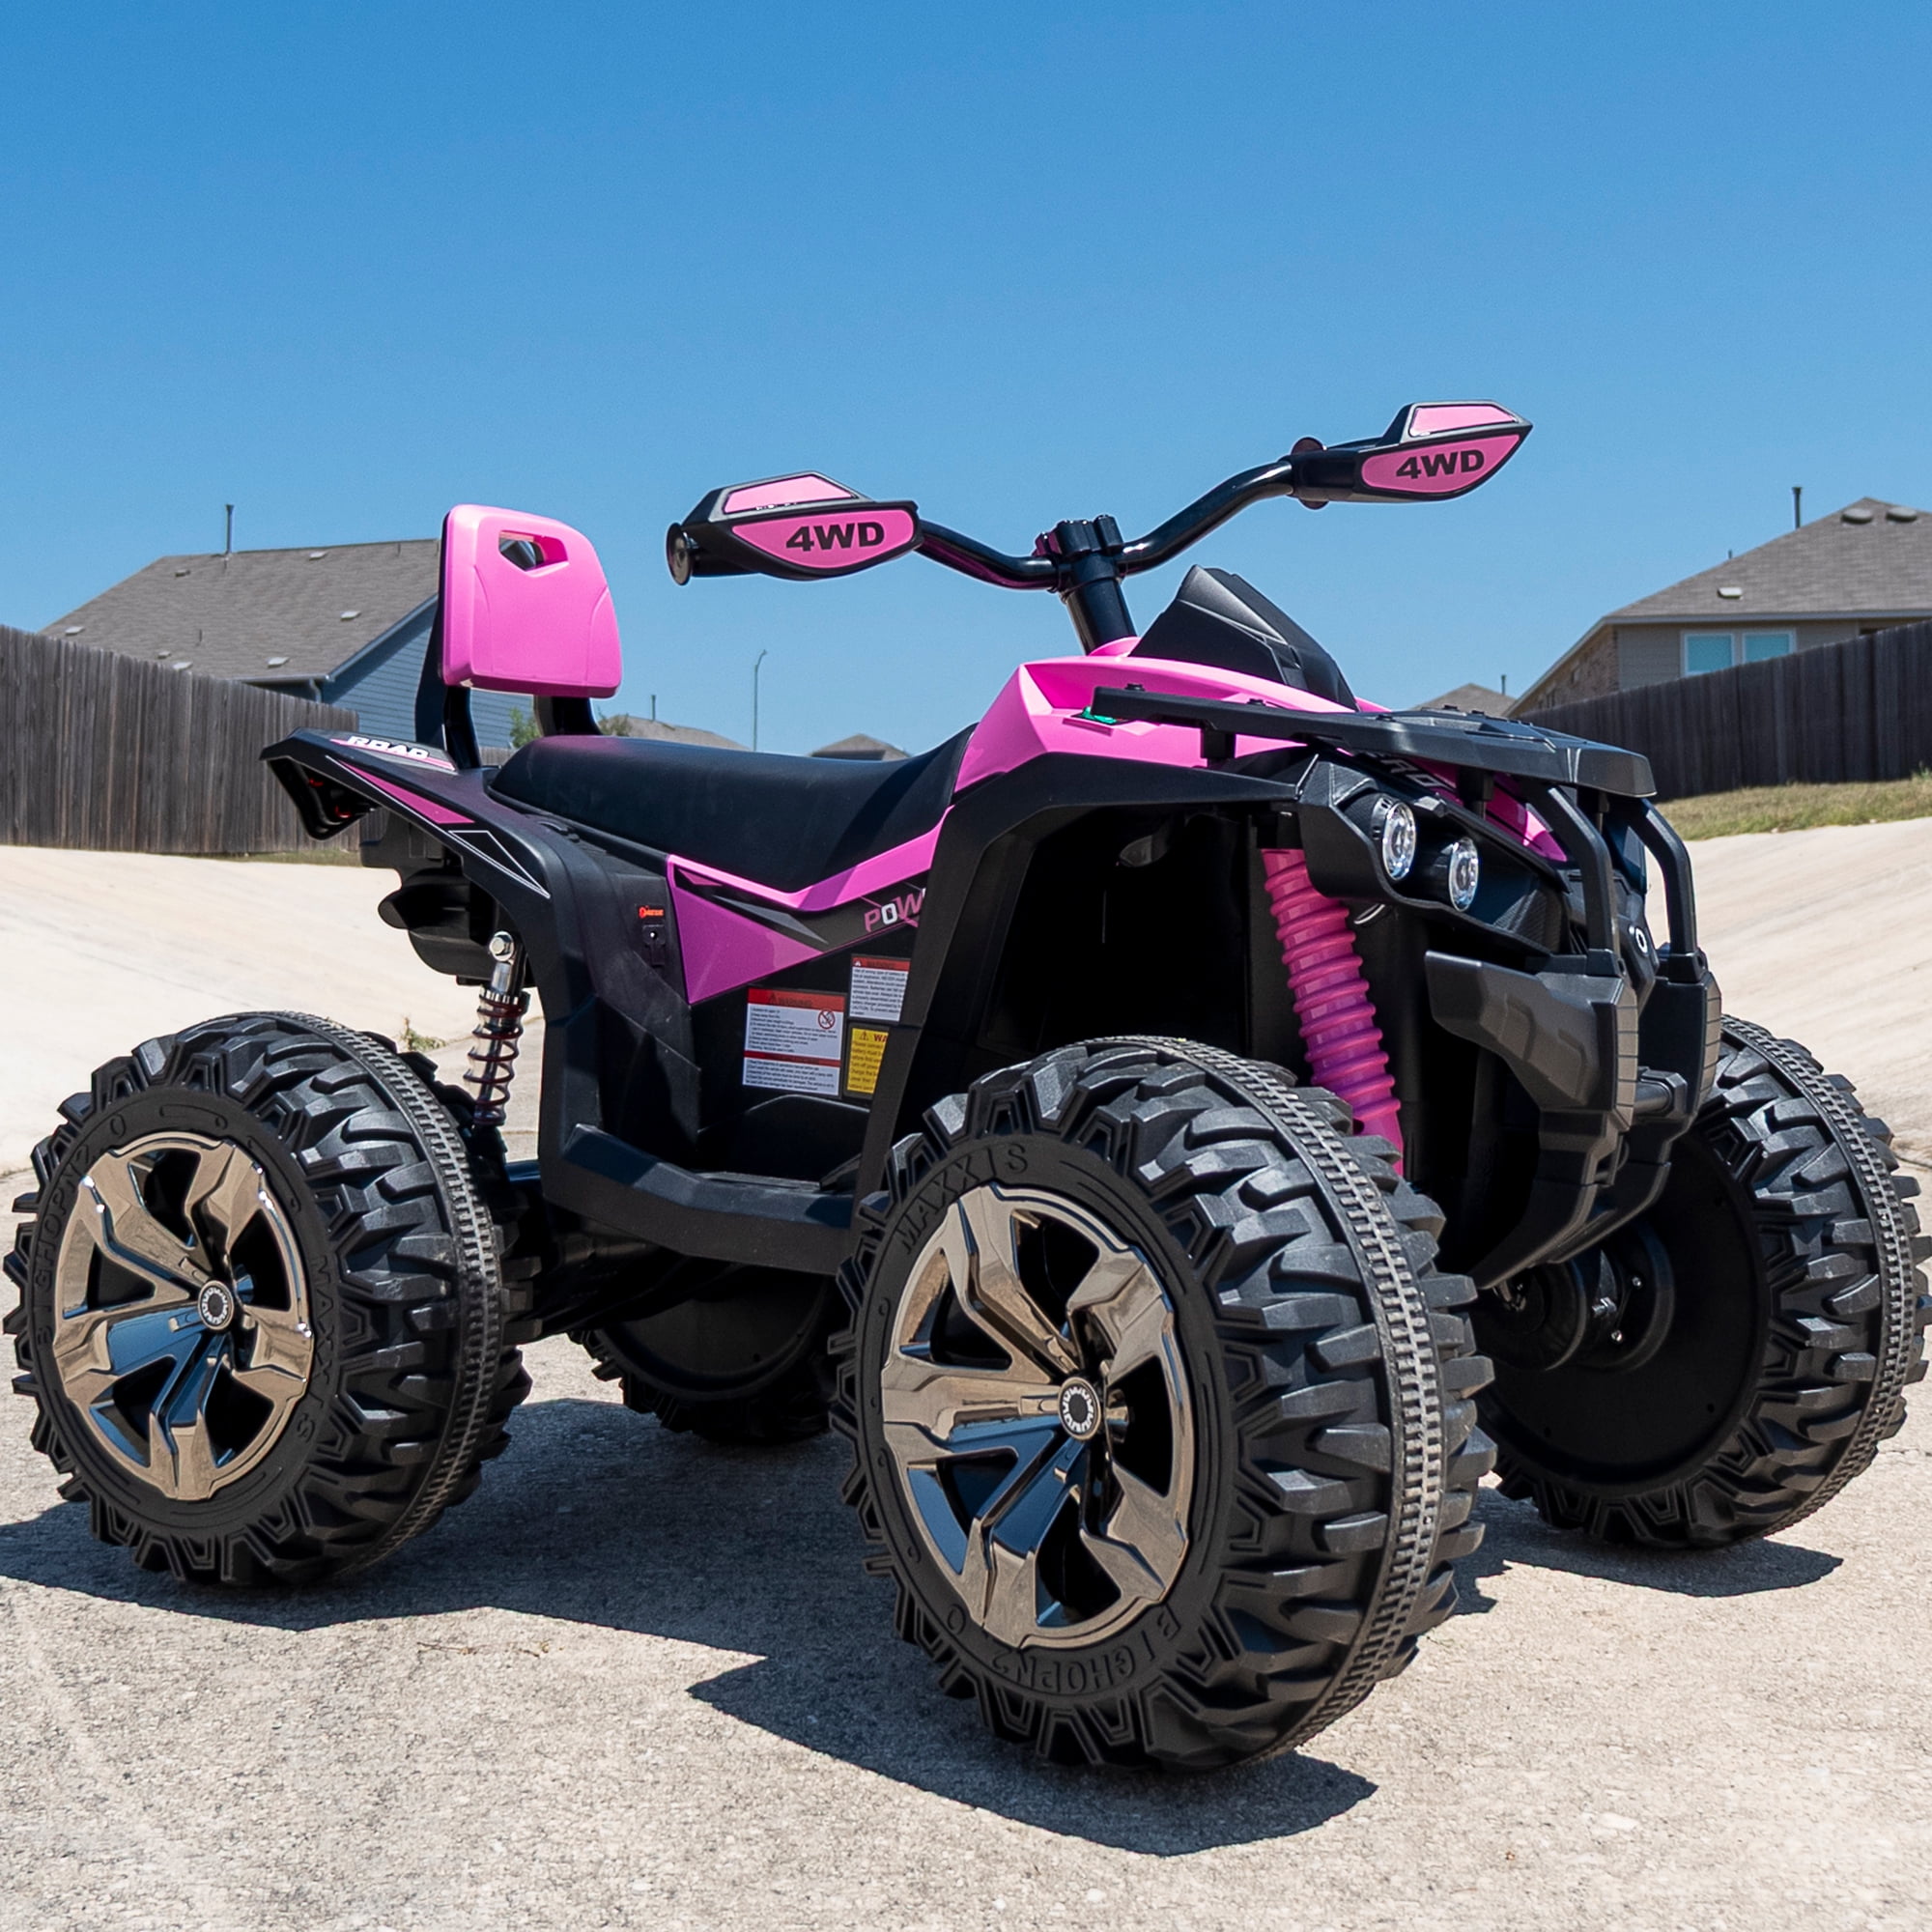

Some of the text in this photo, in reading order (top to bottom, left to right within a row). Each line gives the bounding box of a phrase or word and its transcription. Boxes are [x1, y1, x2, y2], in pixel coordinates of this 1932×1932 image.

[1396, 449, 1485, 479] 4WD
[785, 522, 885, 552] 4WD
[347, 735, 429, 759] ROAD
[864, 887, 926, 933] POW
[895, 1143, 1029, 1255] MAXXIS
[297, 1253, 335, 1444] MAXXIS
